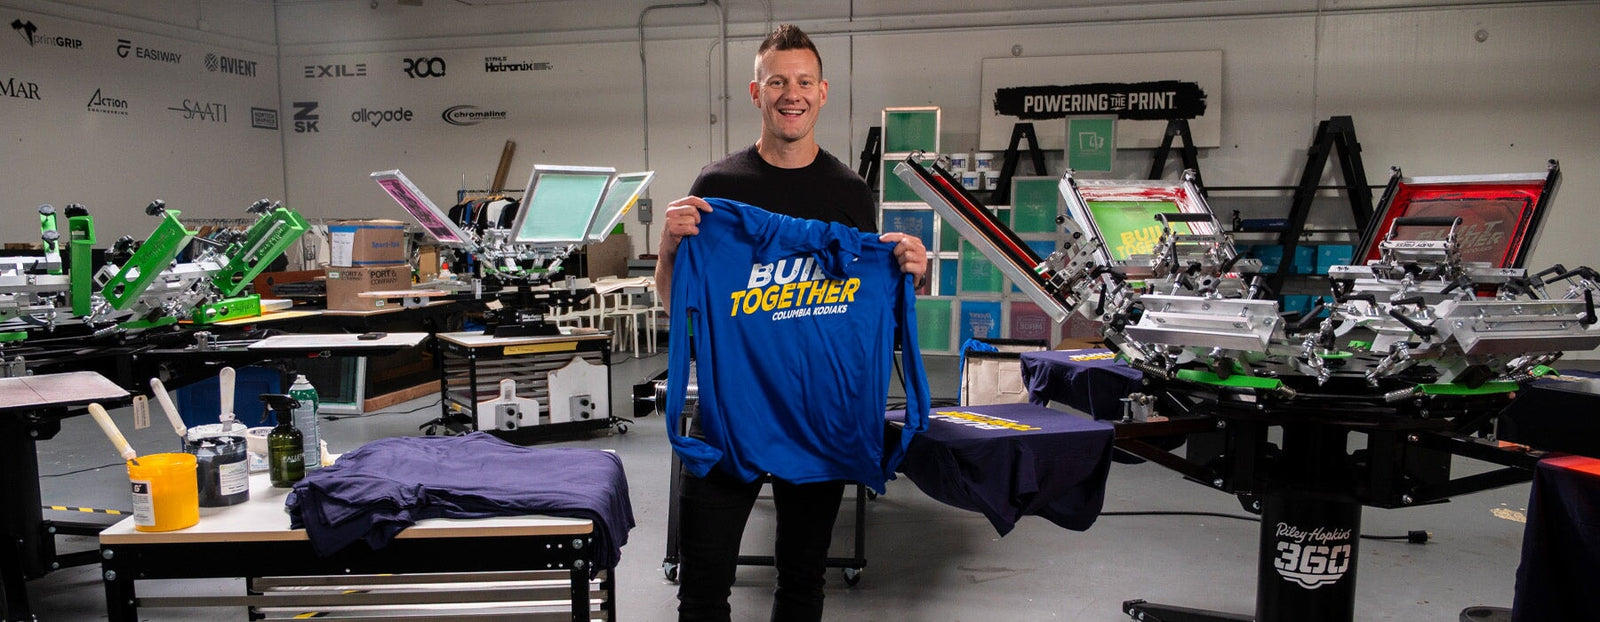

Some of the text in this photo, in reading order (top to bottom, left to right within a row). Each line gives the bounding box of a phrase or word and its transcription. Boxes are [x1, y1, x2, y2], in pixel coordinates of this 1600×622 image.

[34, 35, 83, 49] printGRIP
[136, 47, 182, 64] EASIWAY
[220, 56, 257, 77] AVIENT
[304, 63, 367, 78] EXILE
[403, 56, 446, 78] ROQ
[485, 62, 533, 72] Hotronix
[182, 99, 228, 123] SAATI
[1024, 91, 1176, 113] POWERING THE PRINT
[453, 110, 506, 118] chromaline
[370, 270, 390, 279] PORT
[747, 257, 826, 289] BUIL
[730, 278, 861, 317] TOGETHER
[772, 304, 848, 321] COLUMBIA KODIAKS
[1275, 522, 1352, 545] Riley Hopkins
[1274, 541, 1351, 574] 360
